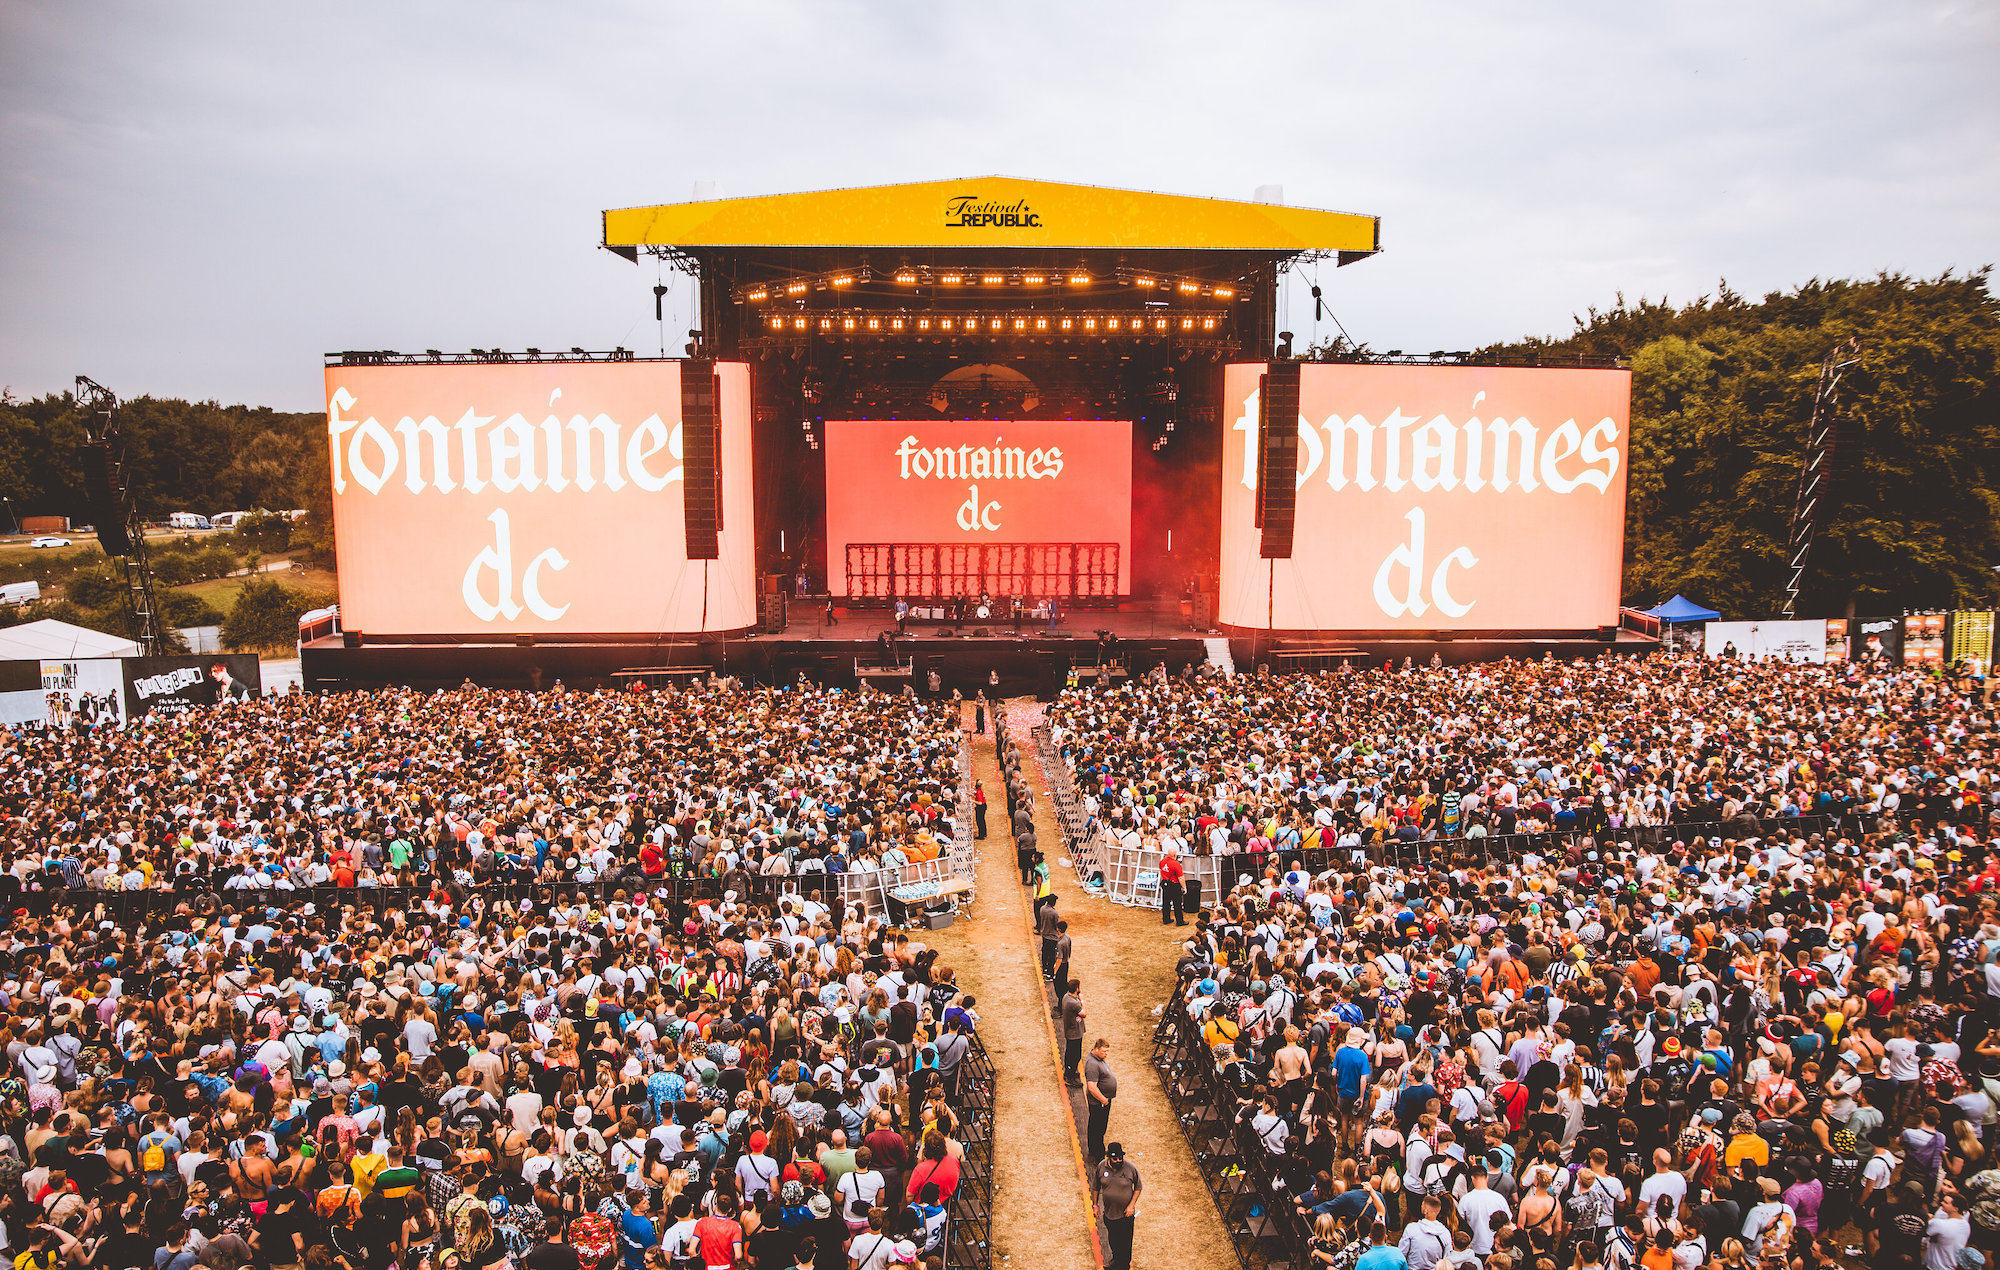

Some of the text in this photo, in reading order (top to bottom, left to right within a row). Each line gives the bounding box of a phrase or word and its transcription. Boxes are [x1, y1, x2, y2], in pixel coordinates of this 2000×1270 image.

[946, 196, 1024, 217] Festival
[895, 435, 1064, 480] fontaines
[956, 484, 1002, 531] dc
[462, 507, 571, 622] dc
[1373, 506, 1480, 619] dc
[52, 676, 77, 689] PLANET
[73, 663, 79, 676] A
[134, 668, 204, 699] YUNGBLUD
